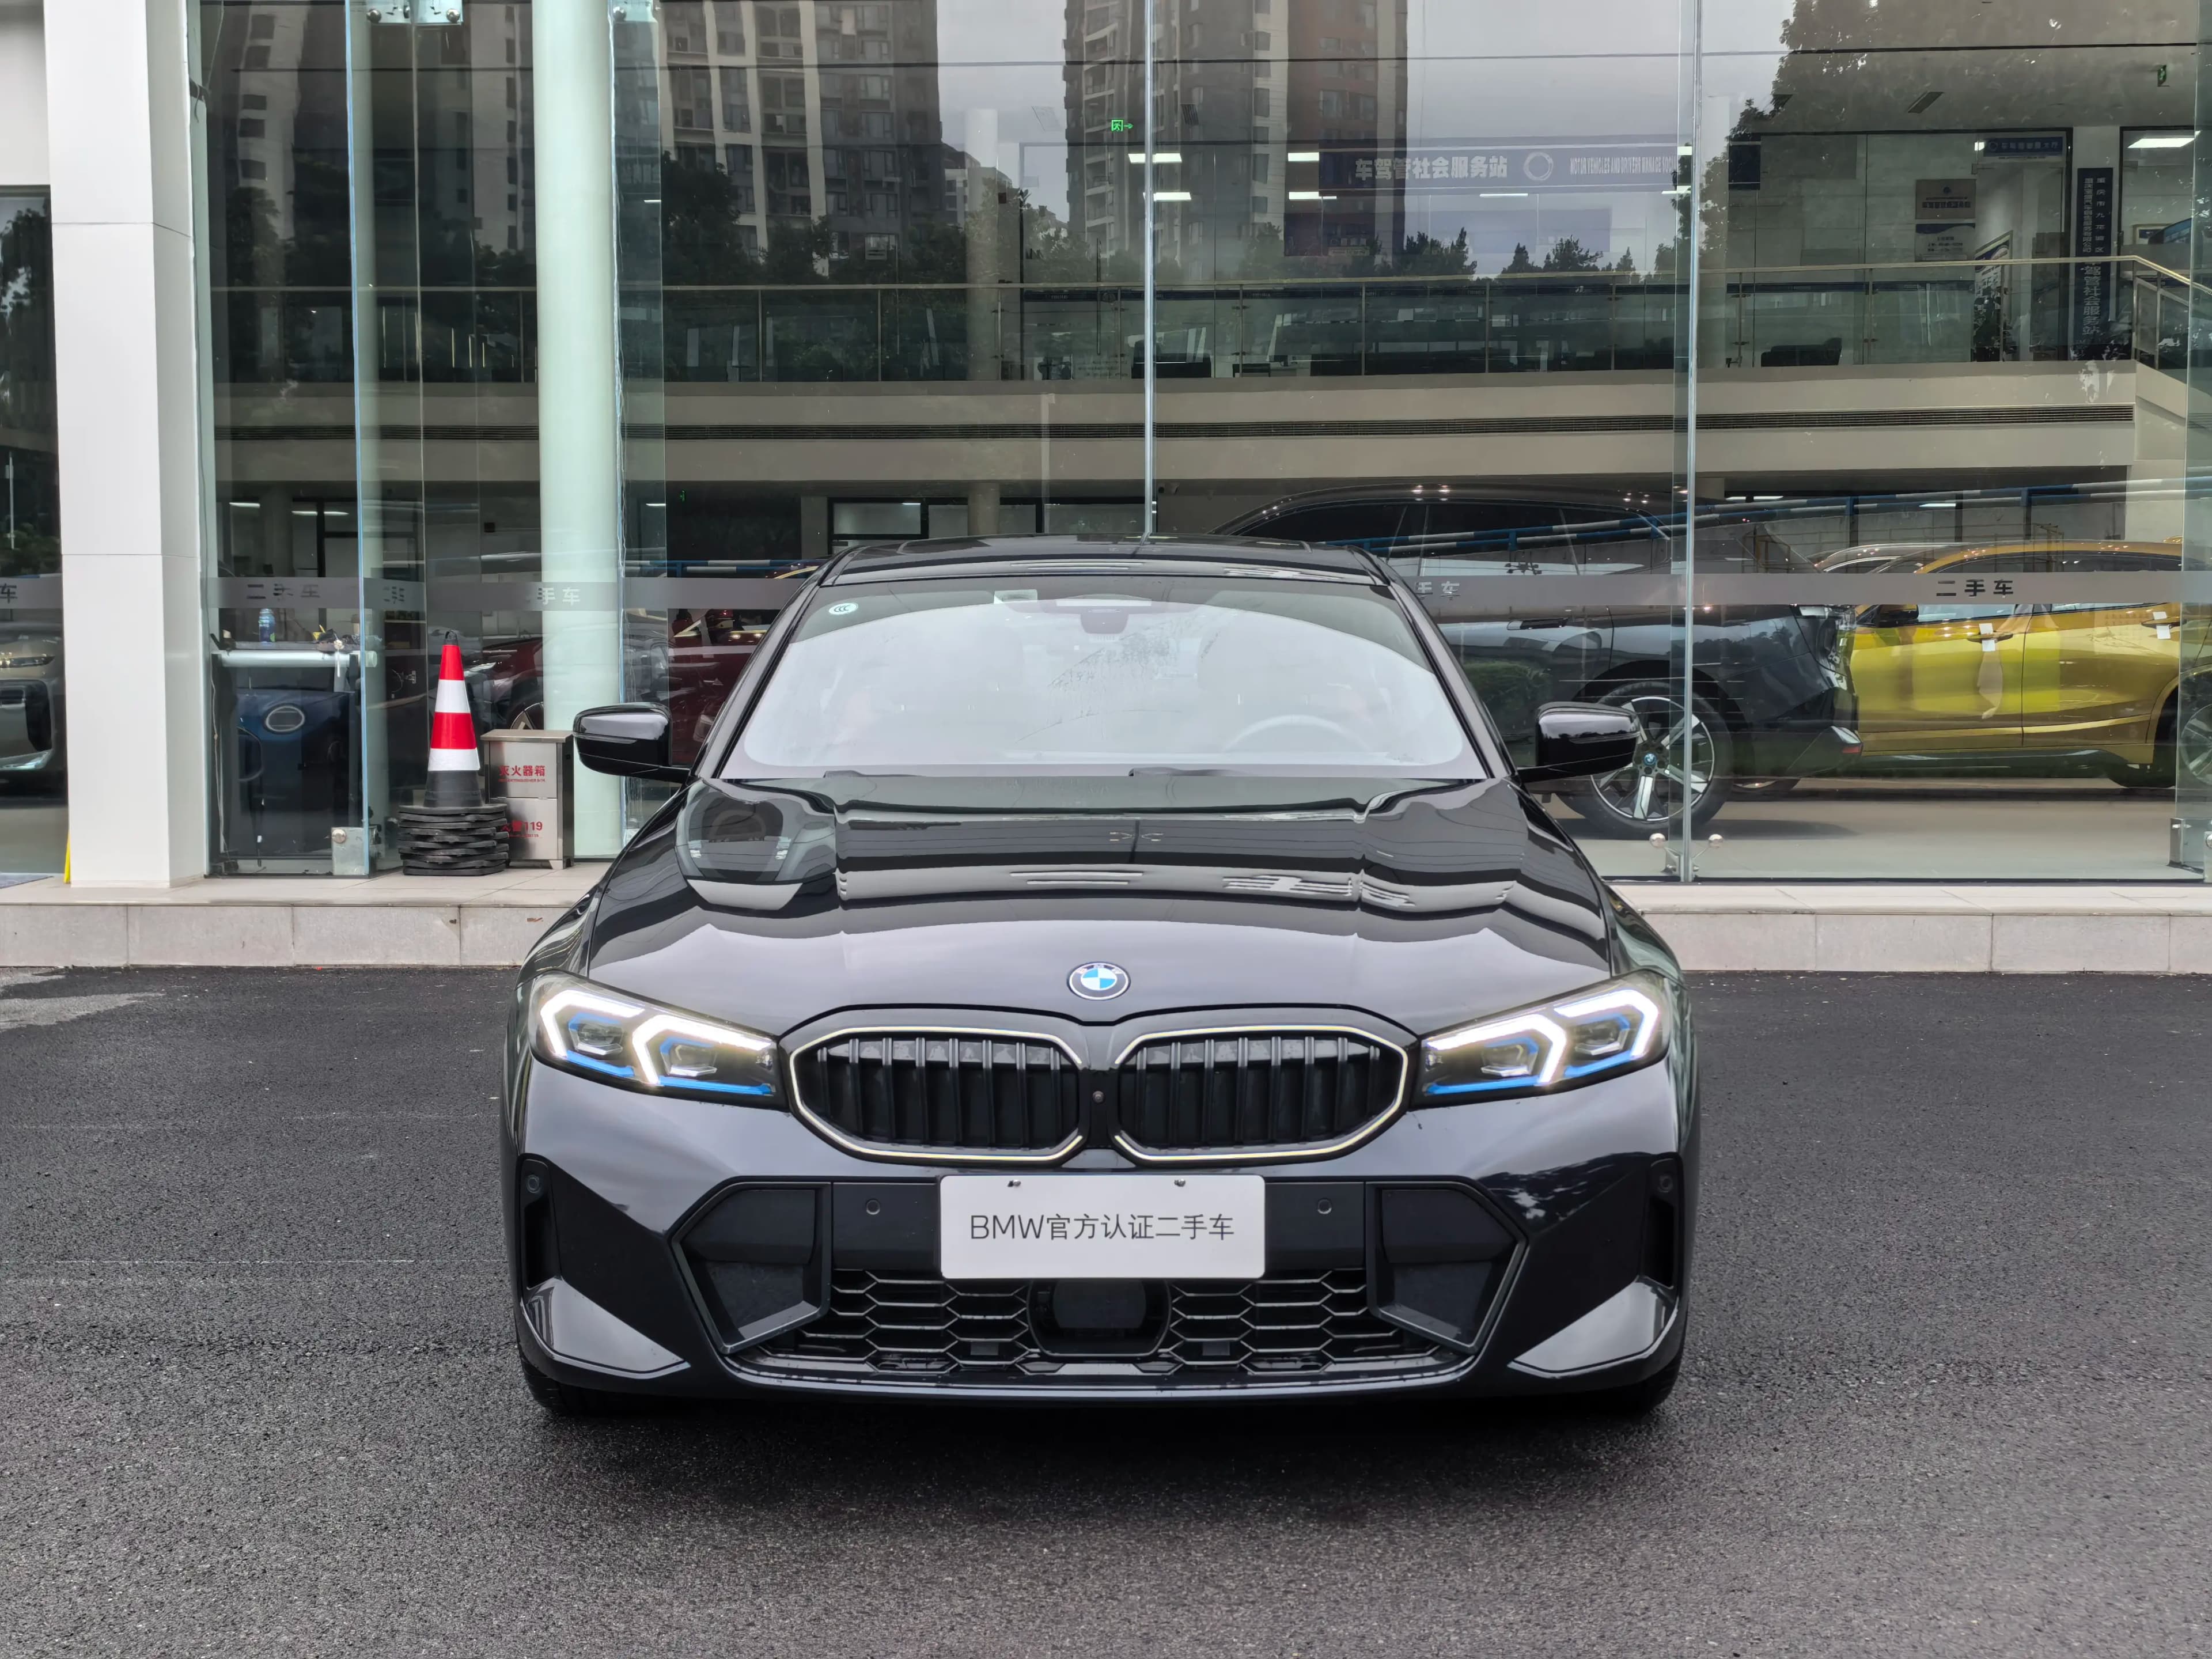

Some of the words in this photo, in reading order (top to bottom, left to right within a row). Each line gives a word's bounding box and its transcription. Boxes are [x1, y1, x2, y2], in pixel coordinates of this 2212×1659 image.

[1355, 155, 1508, 181] 车驾管社会服务站
[0, 583, 18, 604] 车
[1936, 579, 2014, 597] 二手车
[498, 765, 546, 777] 灭火器箱
[971, 1214, 1234, 1240] BMW官方认证二手车
